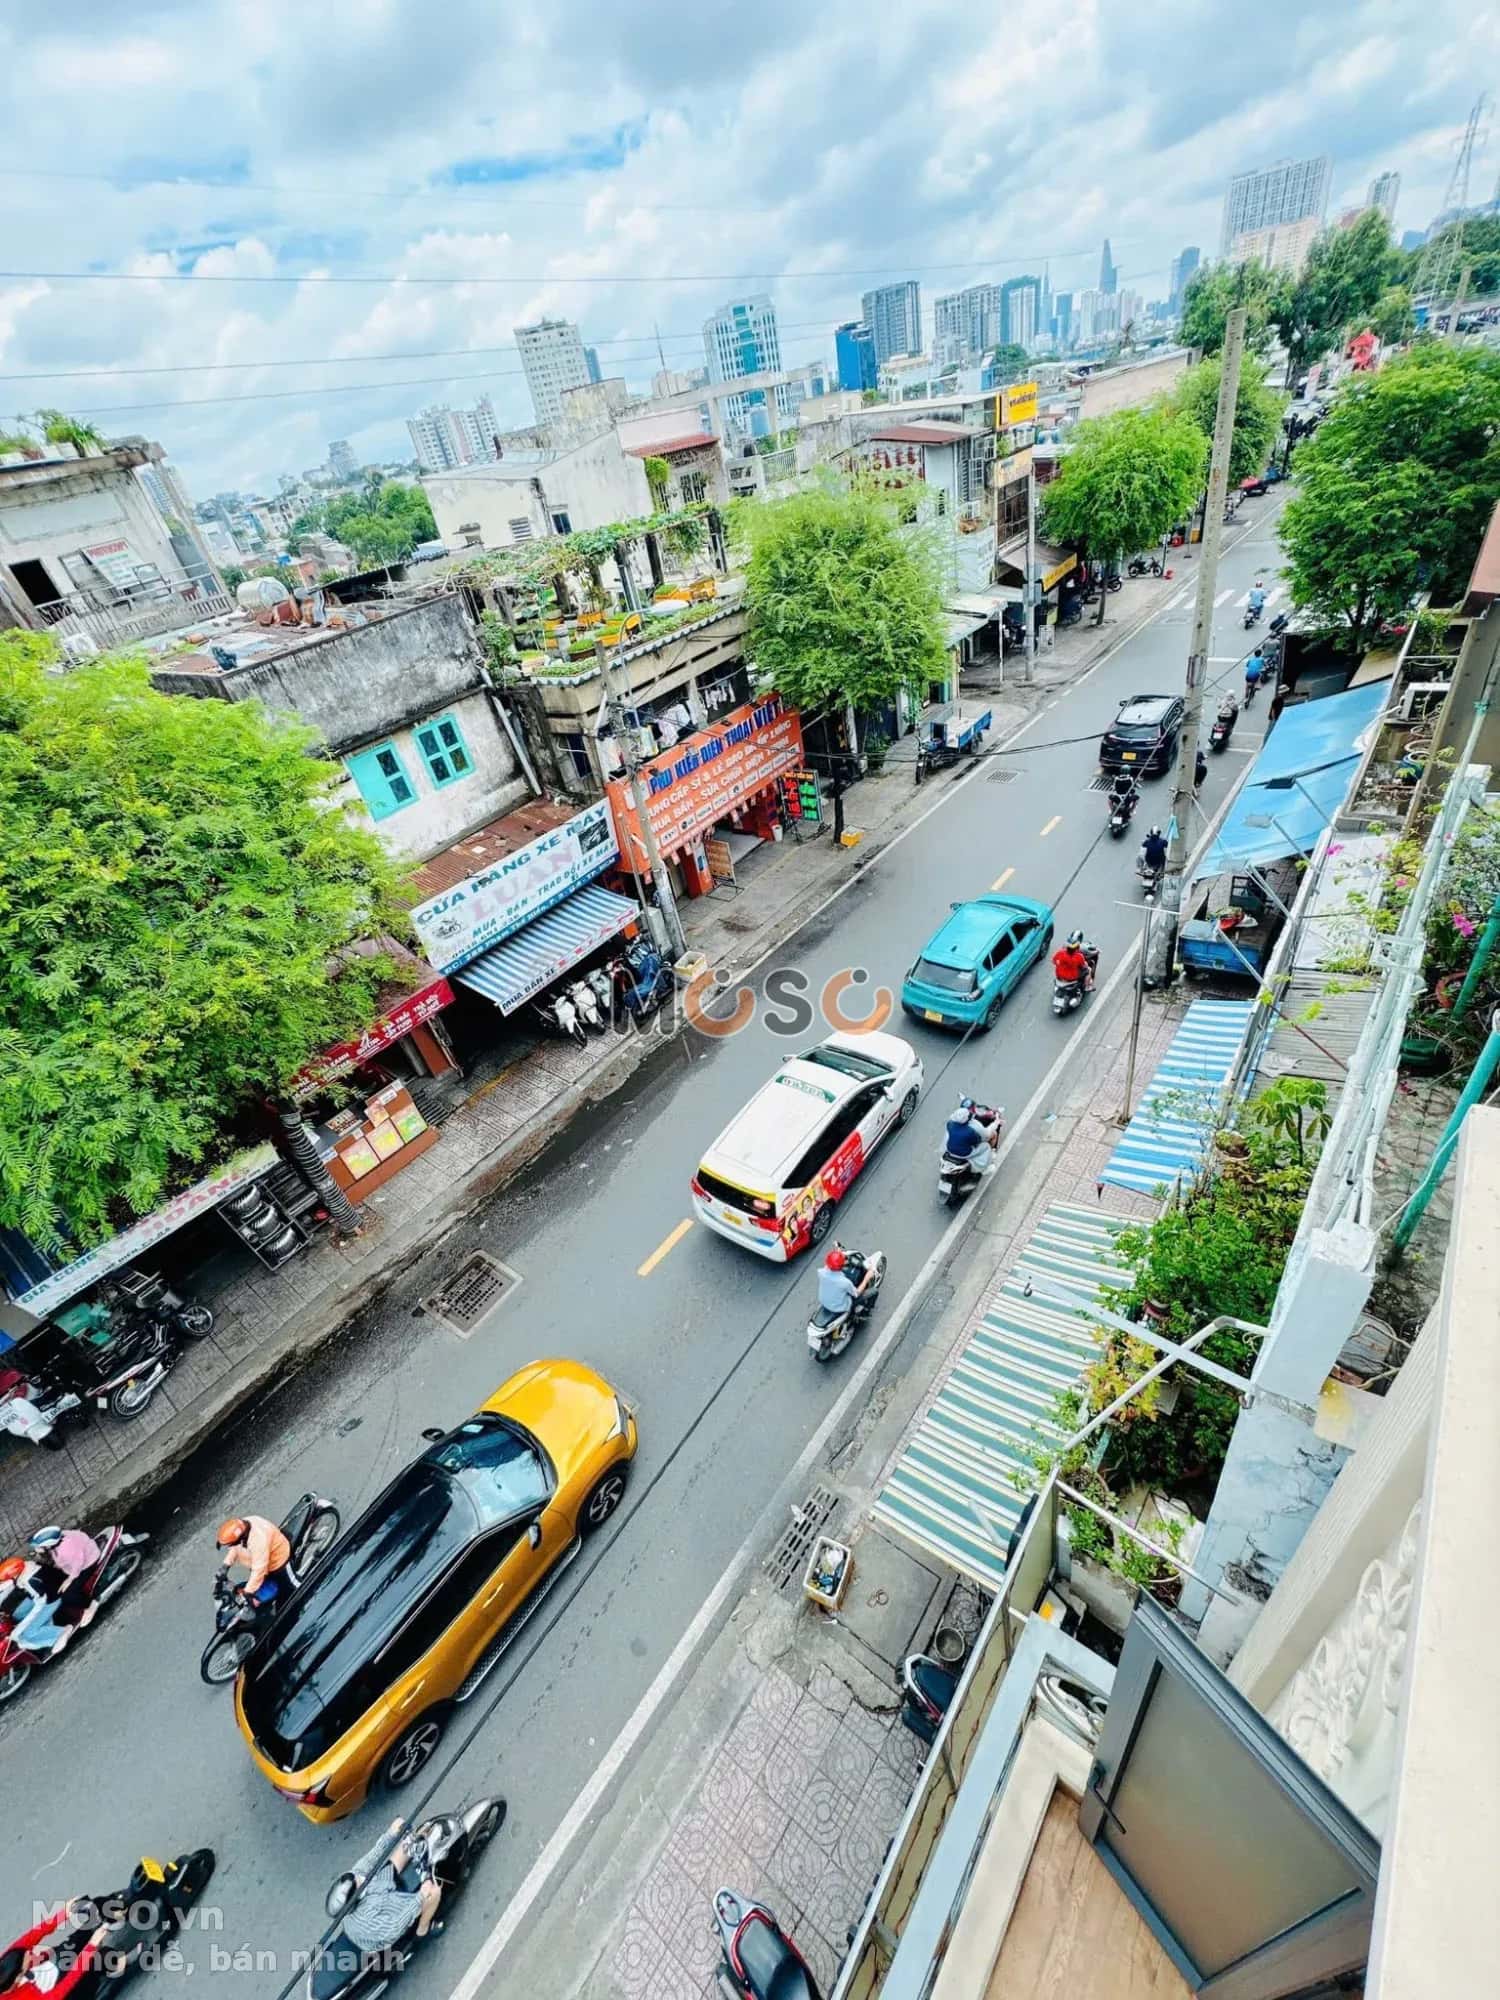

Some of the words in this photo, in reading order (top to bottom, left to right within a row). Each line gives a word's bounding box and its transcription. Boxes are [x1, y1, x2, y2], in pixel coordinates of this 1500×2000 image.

[536, 833, 561, 856] XE
[472, 918, 497, 938] MUA
[500, 992, 524, 1009] MUA
